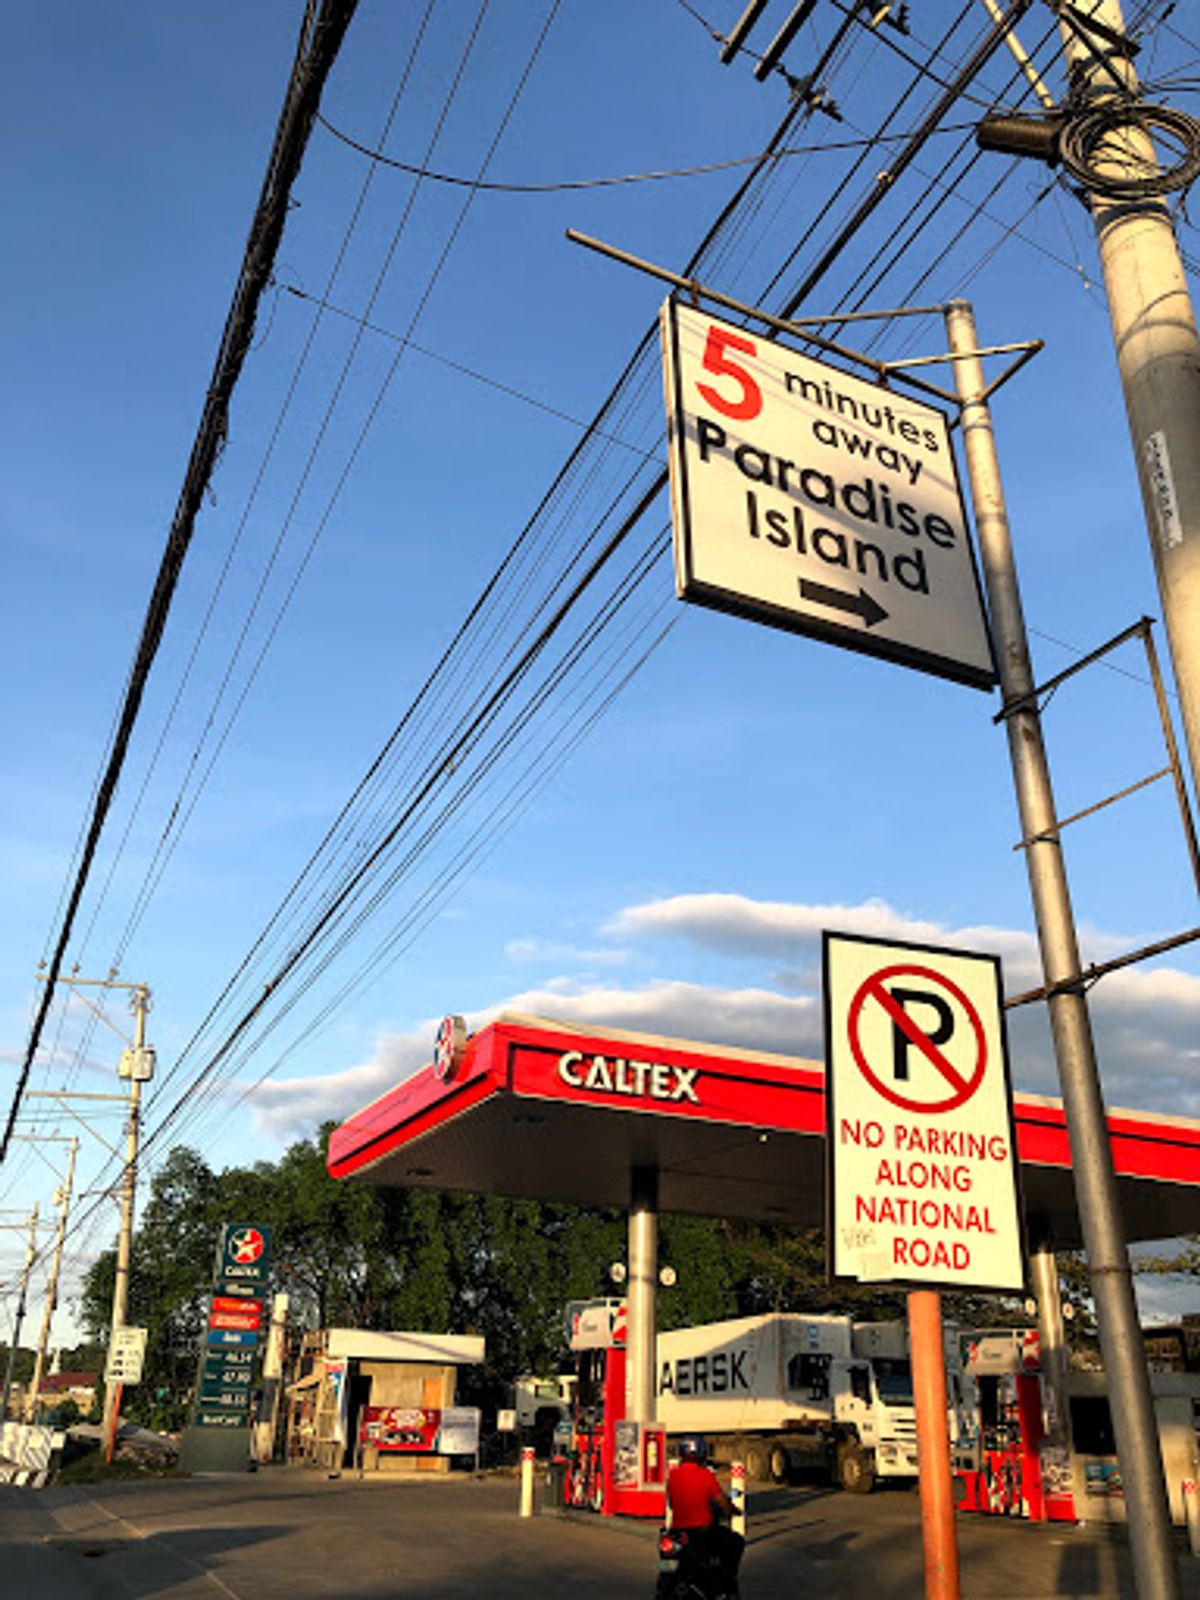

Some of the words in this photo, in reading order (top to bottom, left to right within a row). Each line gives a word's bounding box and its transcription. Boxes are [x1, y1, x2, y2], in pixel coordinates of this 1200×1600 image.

[694, 324, 764, 421] 5
[784, 371, 939, 452] minutes
[812, 419, 922, 484] away
[696, 417, 956, 547] Paradise
[747, 491, 929, 594] Island
[890, 987, 954, 1081] P
[558, 1050, 700, 1103] CALTEX
[841, 1119, 885, 1148] NO
[894, 1125, 1007, 1161] PARKING
[875, 1160, 972, 1191] ALONG
[855, 1195, 996, 1233] NATIONAL
[893, 1237, 970, 1270] ROAD
[653, 1351, 748, 1397] AERSK
